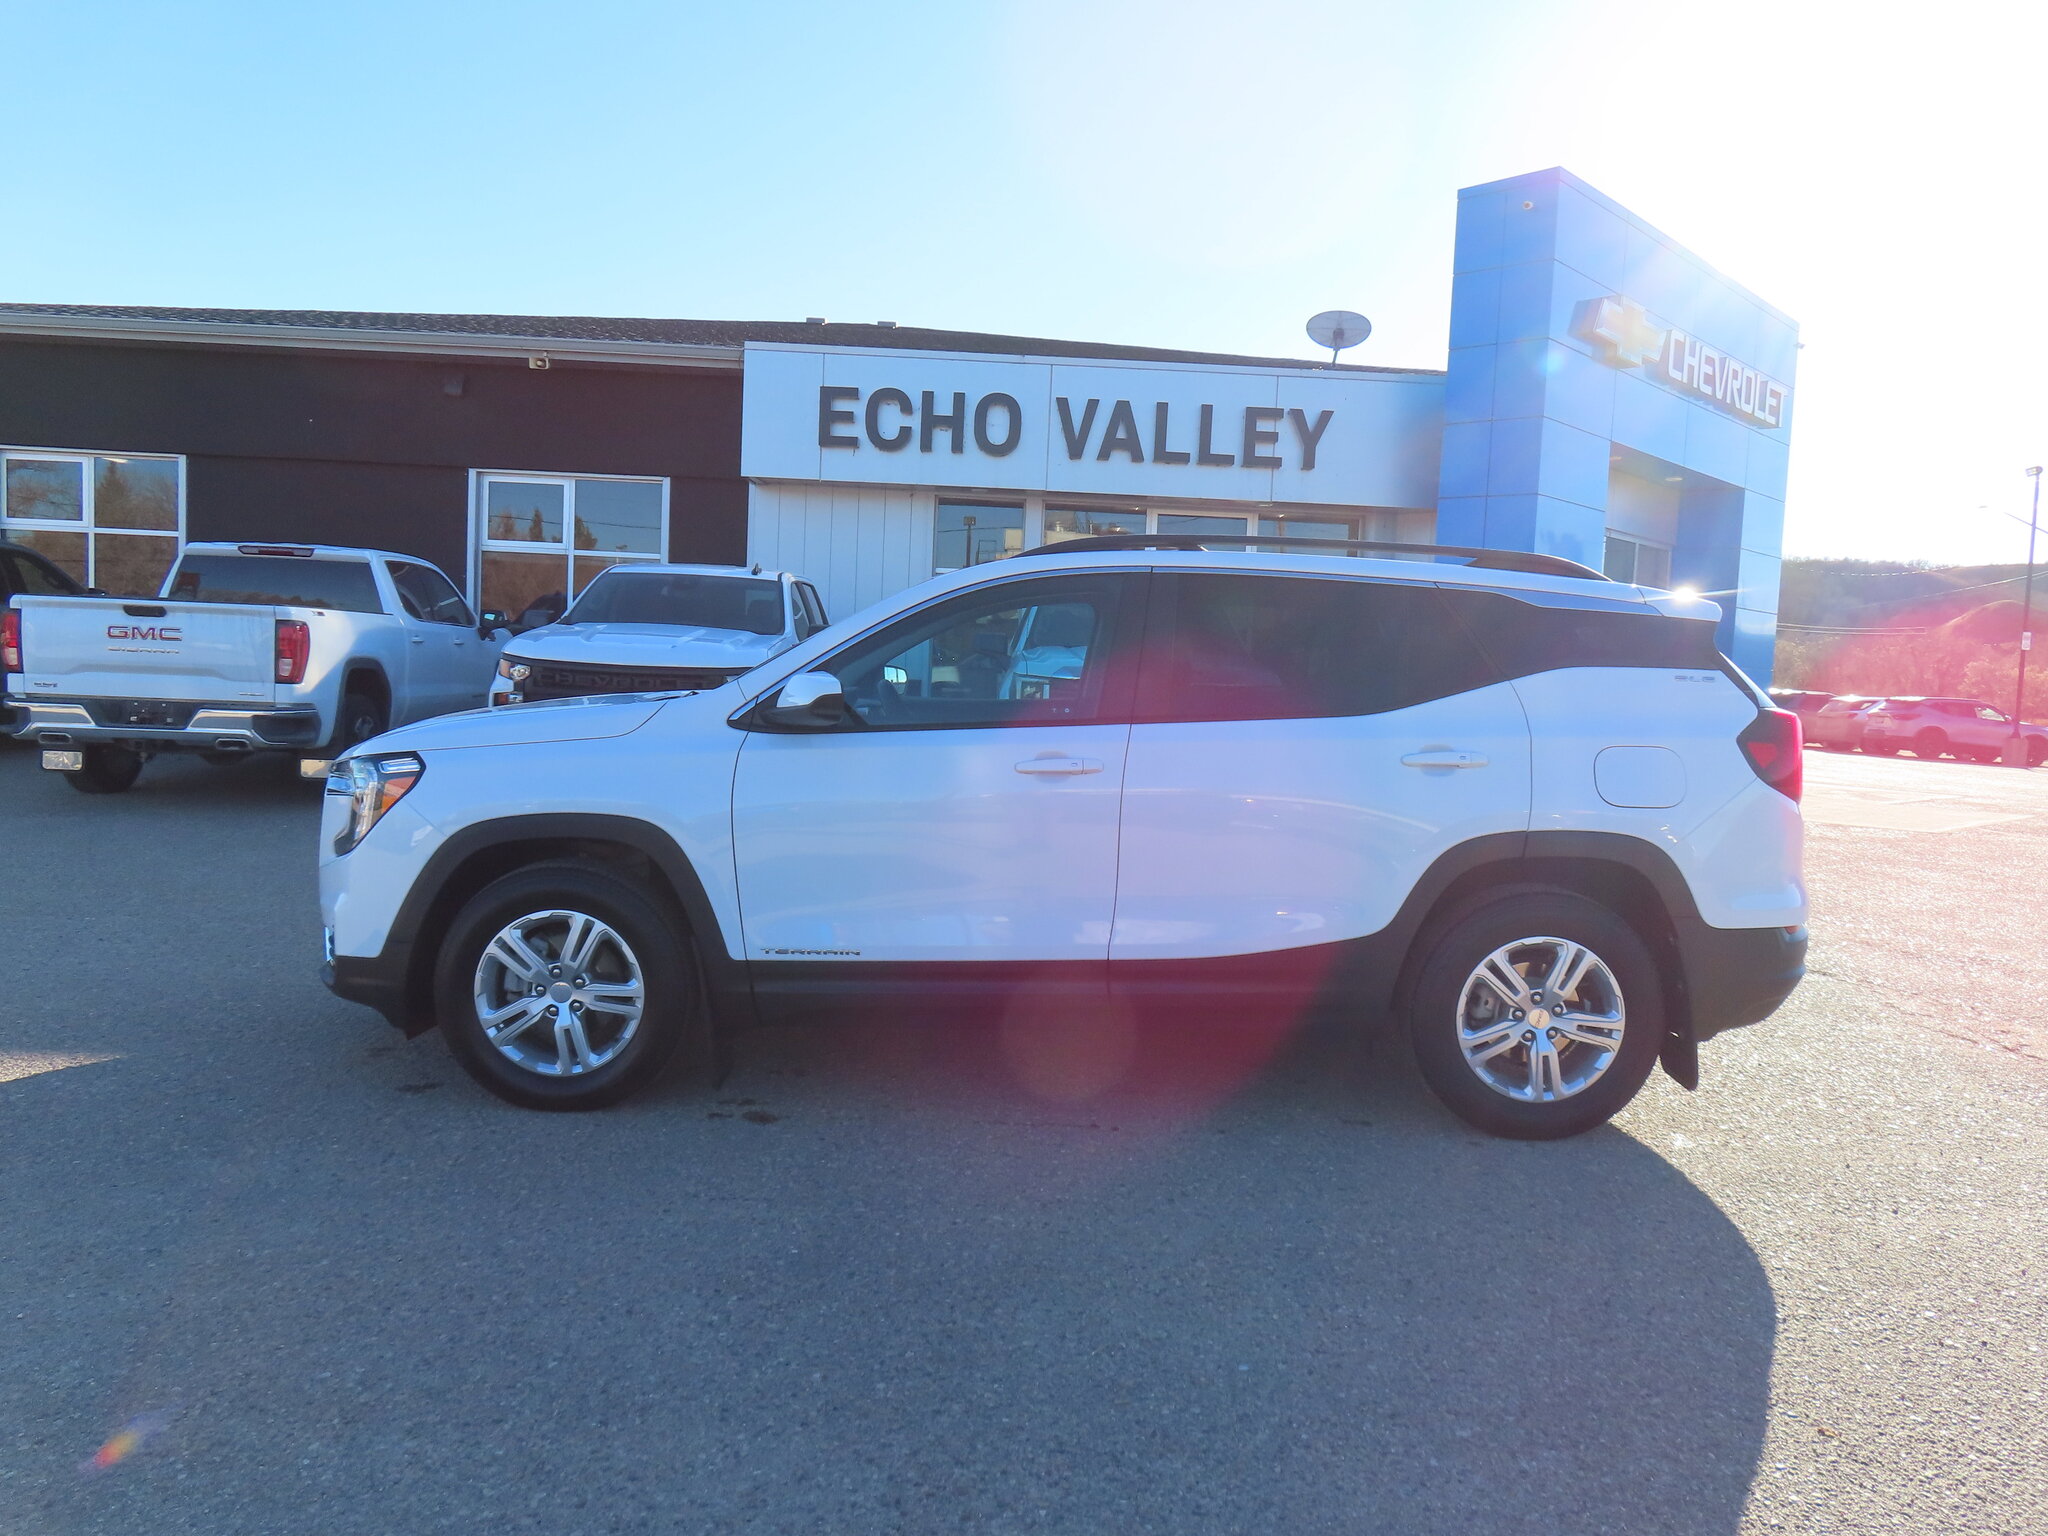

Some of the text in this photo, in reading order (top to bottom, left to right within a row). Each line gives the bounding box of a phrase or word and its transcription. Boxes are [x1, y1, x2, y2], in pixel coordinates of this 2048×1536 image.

[1667, 328, 1787, 428] CHEVROLET
[818, 385, 1335, 471] ECHO VALLEY
[107, 625, 182, 641] GMC
[760, 947, 861, 956] TERRAIN
